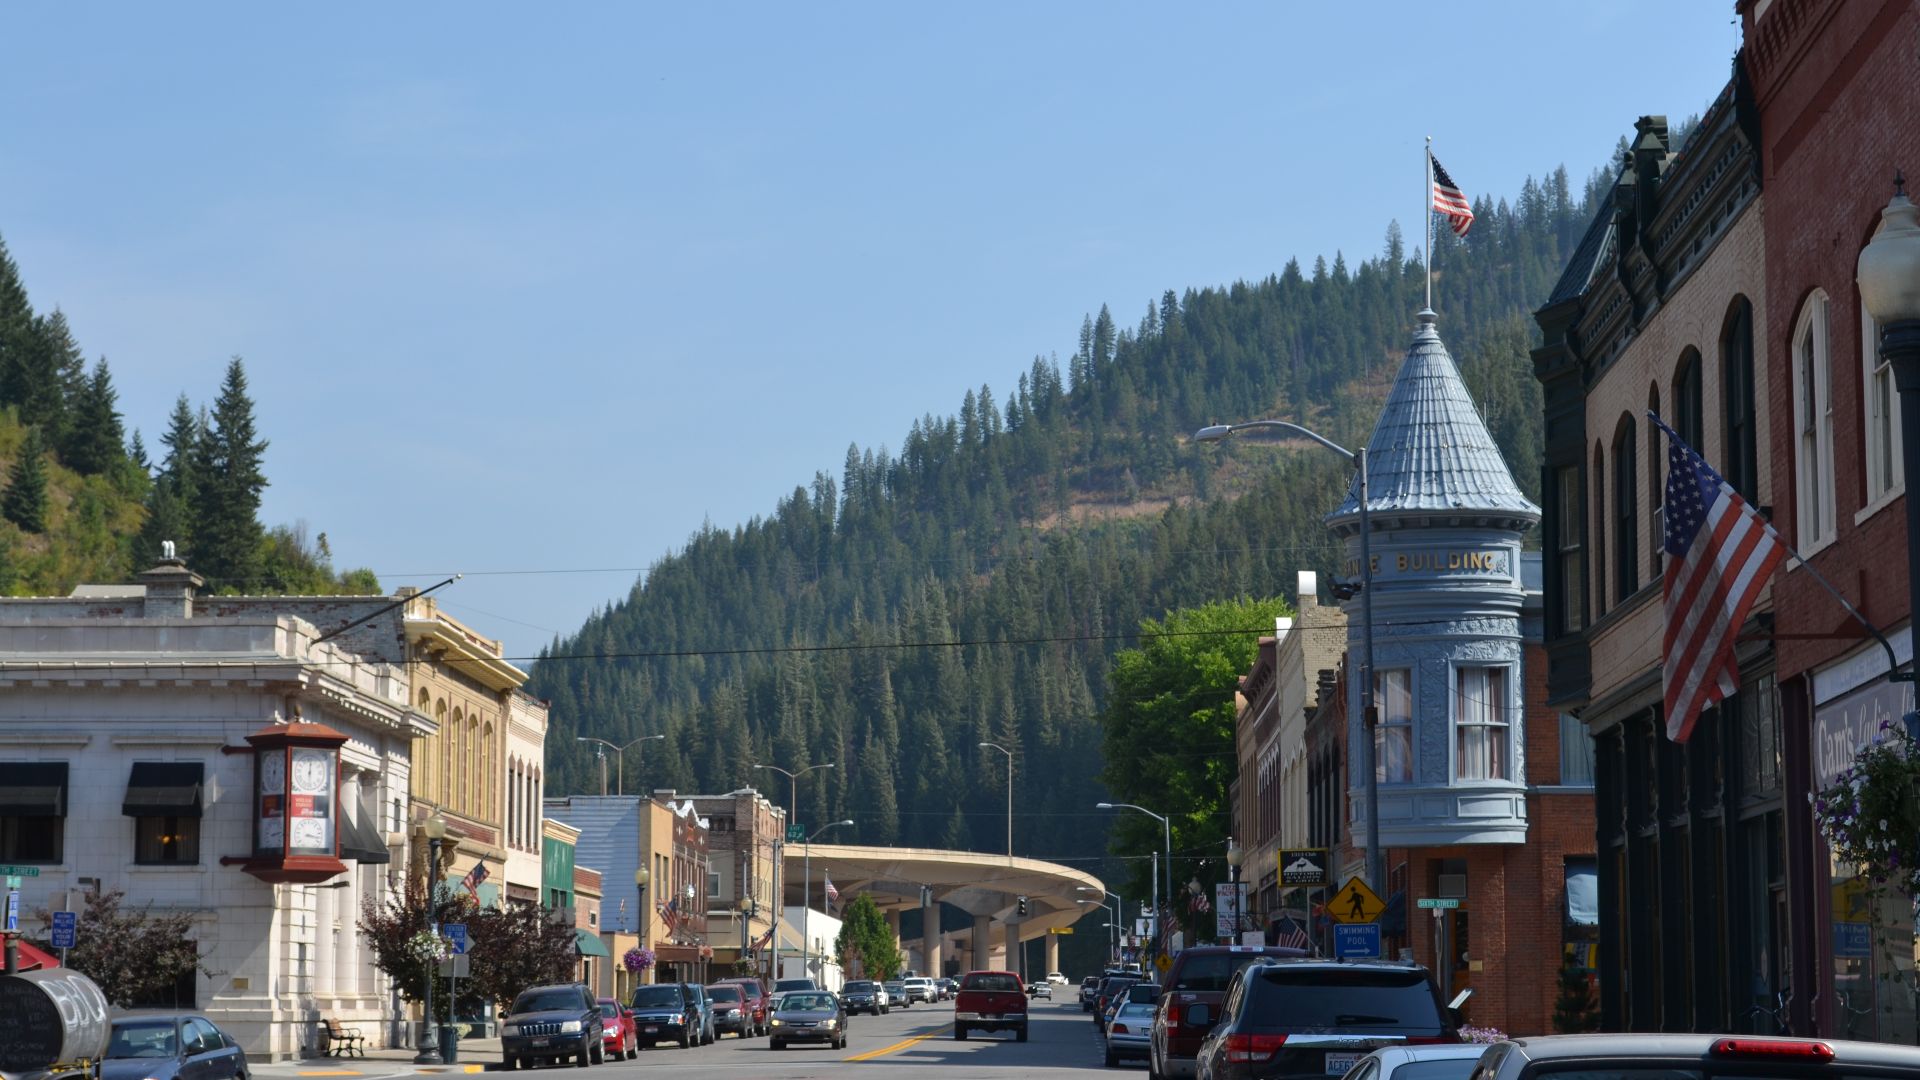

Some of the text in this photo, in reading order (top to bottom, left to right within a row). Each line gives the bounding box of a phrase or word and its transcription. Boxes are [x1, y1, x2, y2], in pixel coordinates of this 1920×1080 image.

[1396, 551, 1494, 571] BUILDING
[1818, 710, 1855, 779] Cam's
[1418, 900, 1458, 908] SIXTH STREET
[1338, 927, 1376, 935] SWIMMING
[1347, 936, 1367, 945] POOL
